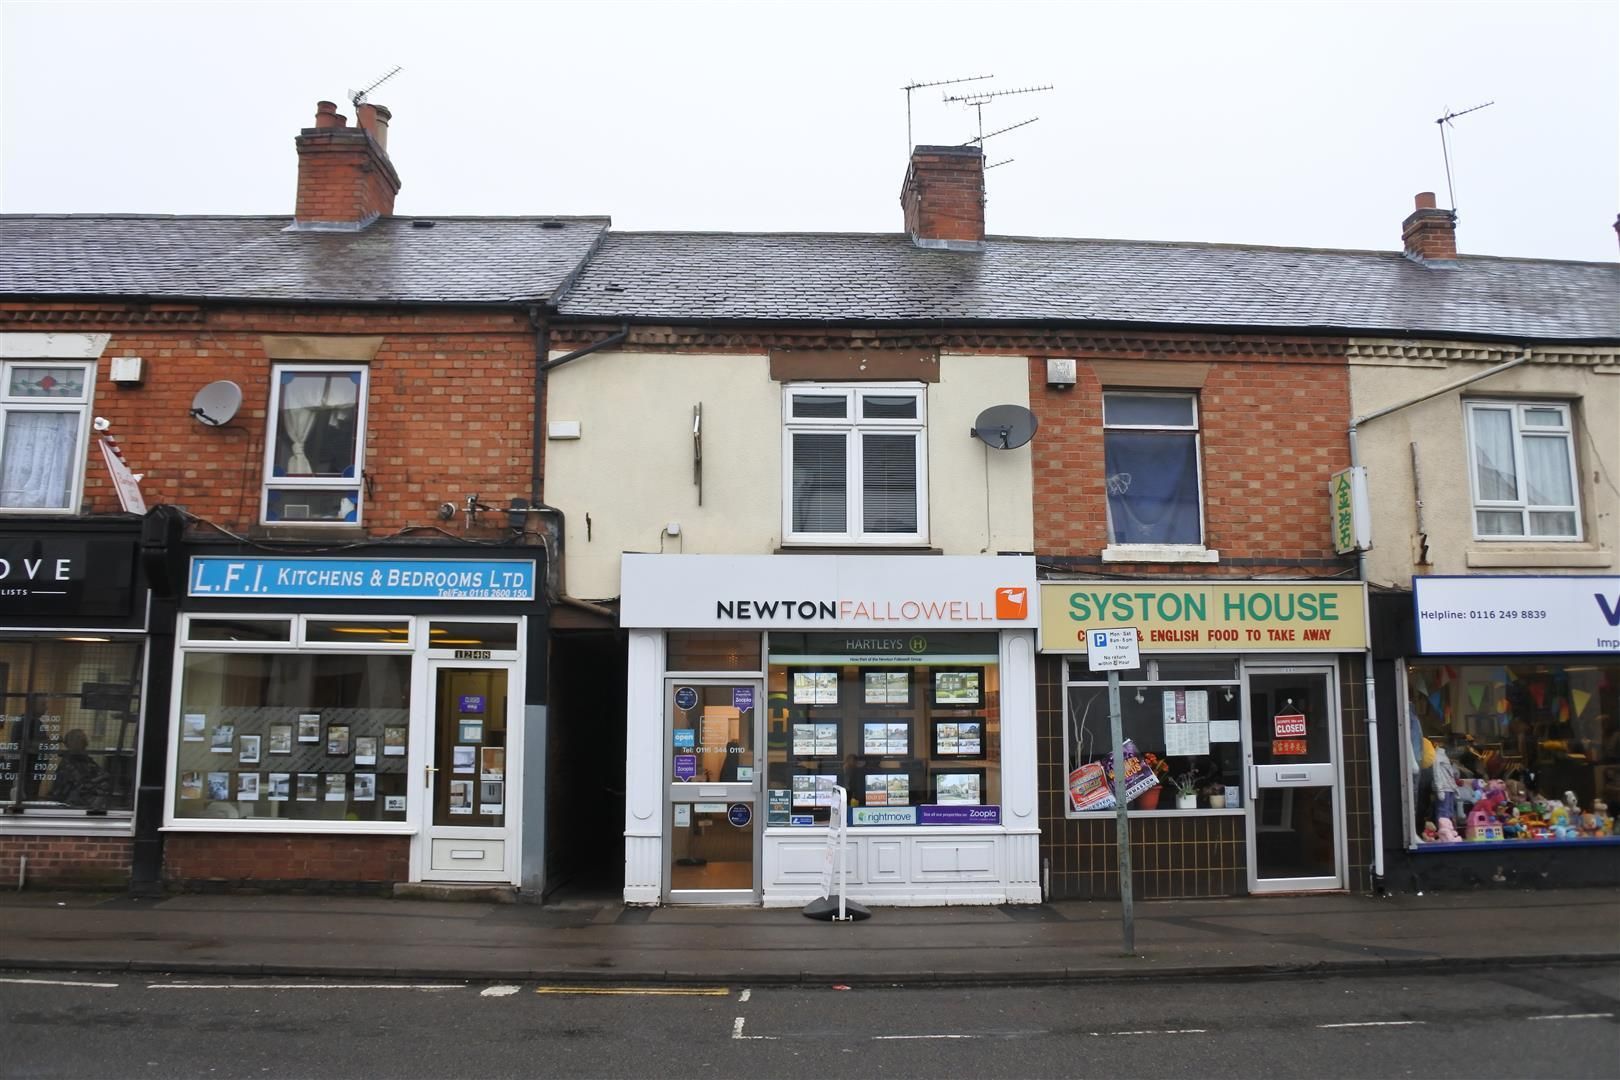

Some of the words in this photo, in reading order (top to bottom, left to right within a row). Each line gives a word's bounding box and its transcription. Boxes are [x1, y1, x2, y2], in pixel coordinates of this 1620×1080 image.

[193, 562, 269, 592] L.F.I.
[277, 567, 364, 587] KITCHENS
[370, 568, 383, 587] &
[387, 568, 483, 588] BEDROOMS
[489, 569, 525, 588] LTD
[469, 588, 489, 597] 0116
[491, 589, 510, 598] 2600
[512, 589, 528, 598] 150
[1068, 592, 1207, 622] SYSTON
[1224, 592, 1340, 621] HOUSE
[1421, 610, 1467, 622] Helpline:
[1470, 610, 1495, 620] 0116
[1499, 610, 1518, 620] 249
[1521, 610, 1546, 620] 8839
[1150, 629, 1199, 642] ENGLISH
[1207, 629, 1239, 642] FOOD
[1246, 629, 1261, 642] TO
[1267, 629, 1296, 642] TAKE
[1303, 628, 1332, 641] AWAY
[846, 639, 903, 650] HARTLEYS
[1277, 724, 1304, 734] CLOSED
[675, 734, 694, 742] open
[868, 812, 911, 823] rightmove
[969, 809, 996, 818] Zoopla
